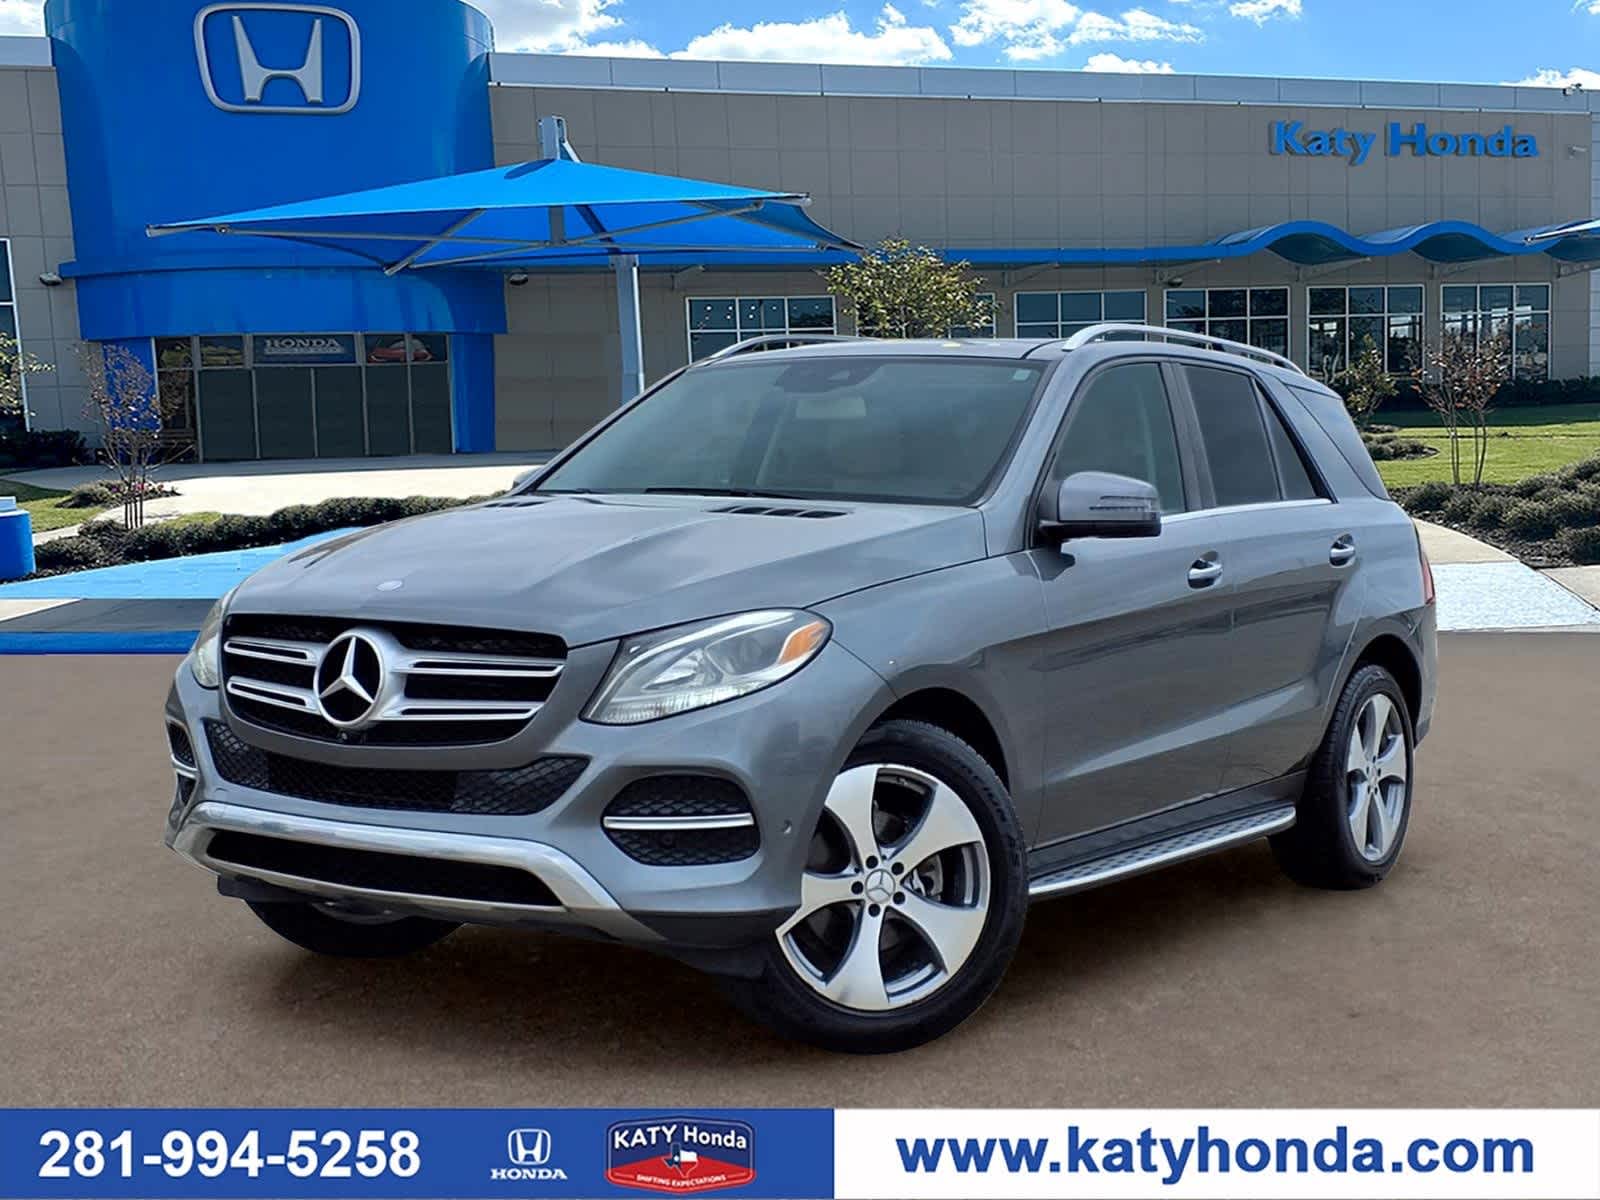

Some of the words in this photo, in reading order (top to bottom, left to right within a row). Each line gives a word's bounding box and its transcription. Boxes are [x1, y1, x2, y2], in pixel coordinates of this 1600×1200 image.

[1272, 120, 1377, 165] Katy
[1386, 122, 1540, 157] Honda
[265, 338, 341, 348] HONDA
